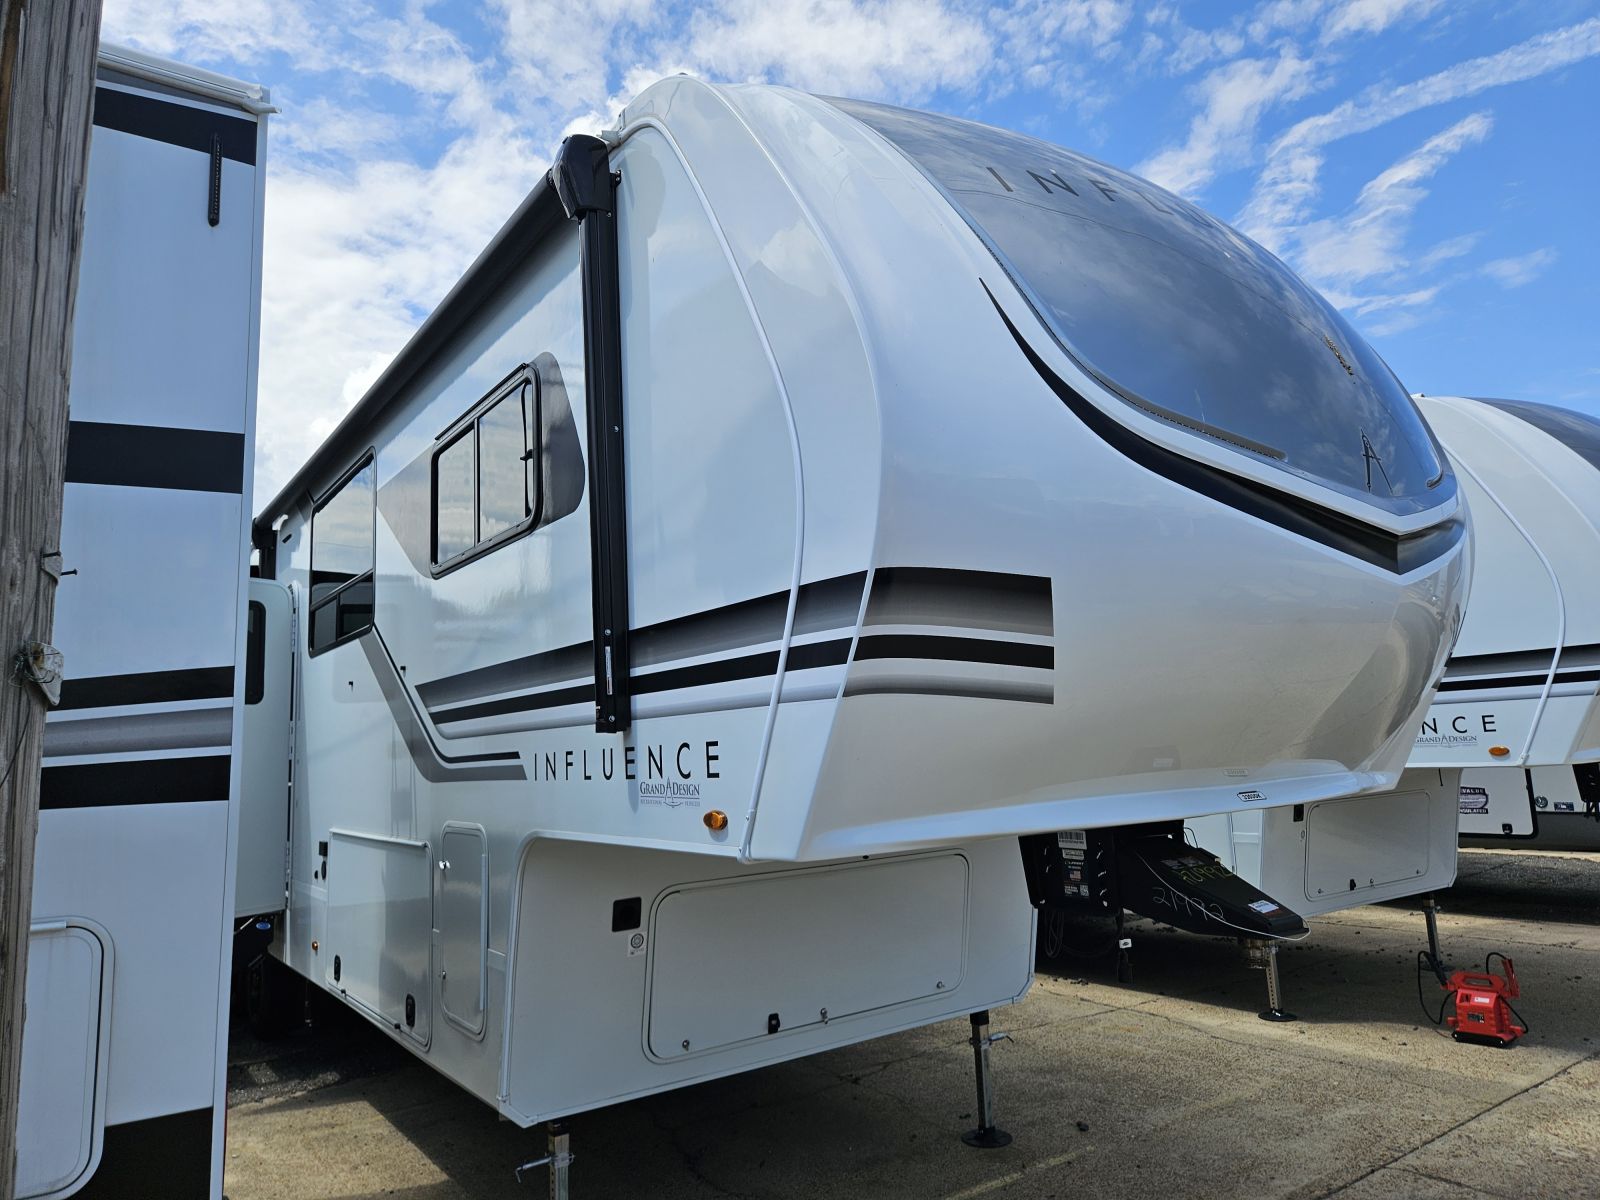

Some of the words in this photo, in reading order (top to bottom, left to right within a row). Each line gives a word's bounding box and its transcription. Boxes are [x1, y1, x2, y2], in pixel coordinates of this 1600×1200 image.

[533, 740, 721, 782] INFLUENCE
[640, 781, 666, 795] GRAND
[672, 781, 700, 796] DESIGN
